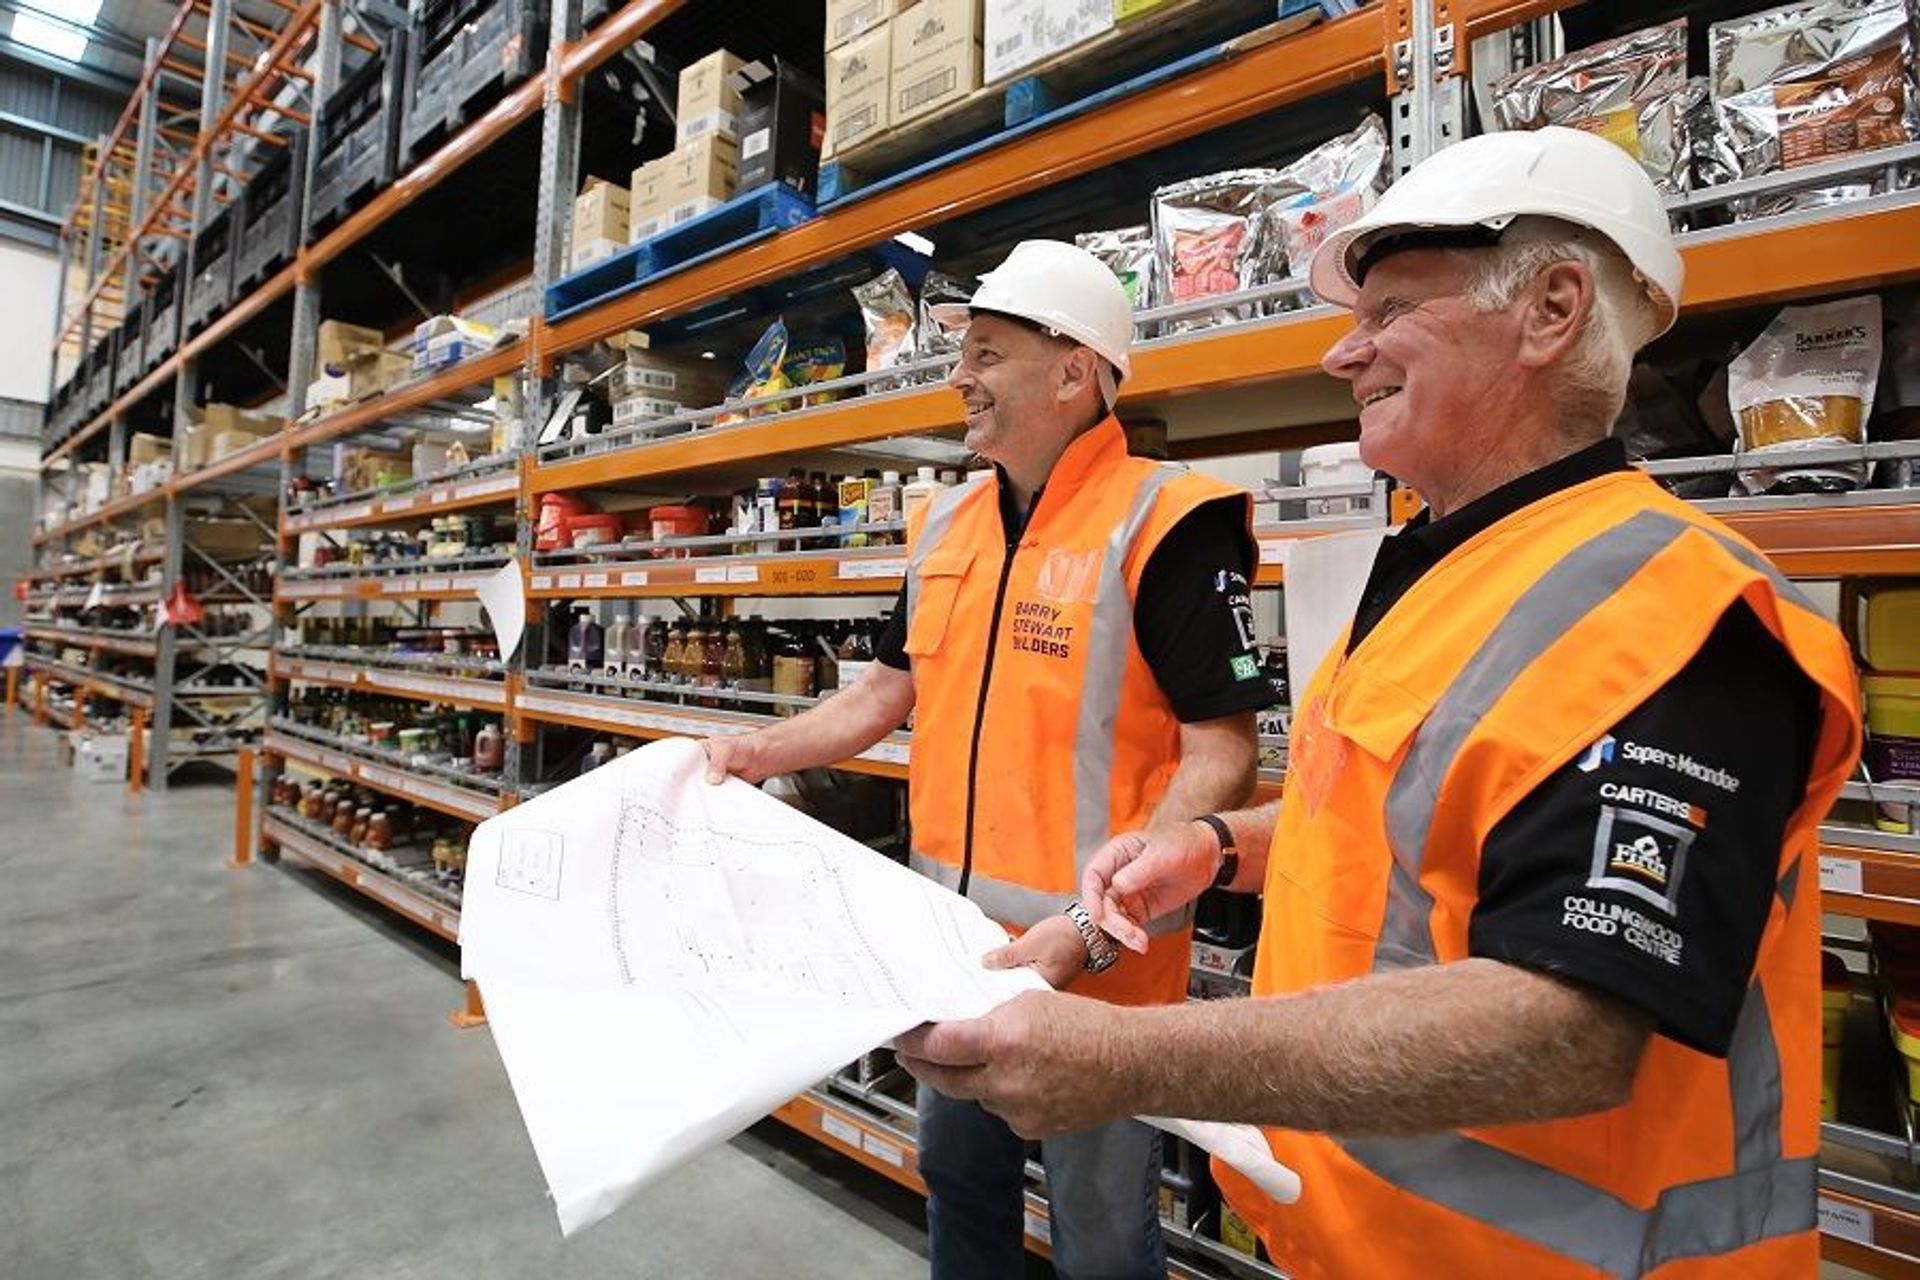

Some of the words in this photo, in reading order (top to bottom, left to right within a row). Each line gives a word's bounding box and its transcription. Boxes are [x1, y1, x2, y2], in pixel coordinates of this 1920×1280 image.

[1015, 601, 1062, 621] BARRY
[1013, 618, 1074, 641] STEWART
[1621, 741, 1677, 770] Sopers
[1600, 782, 1691, 819] CARTERS
[1611, 842, 1667, 877] Firth
[1562, 911, 1618, 936] FOOD
[1623, 927, 1681, 966] CENTRE
[1563, 896, 1683, 950] COLLINGWOOD
